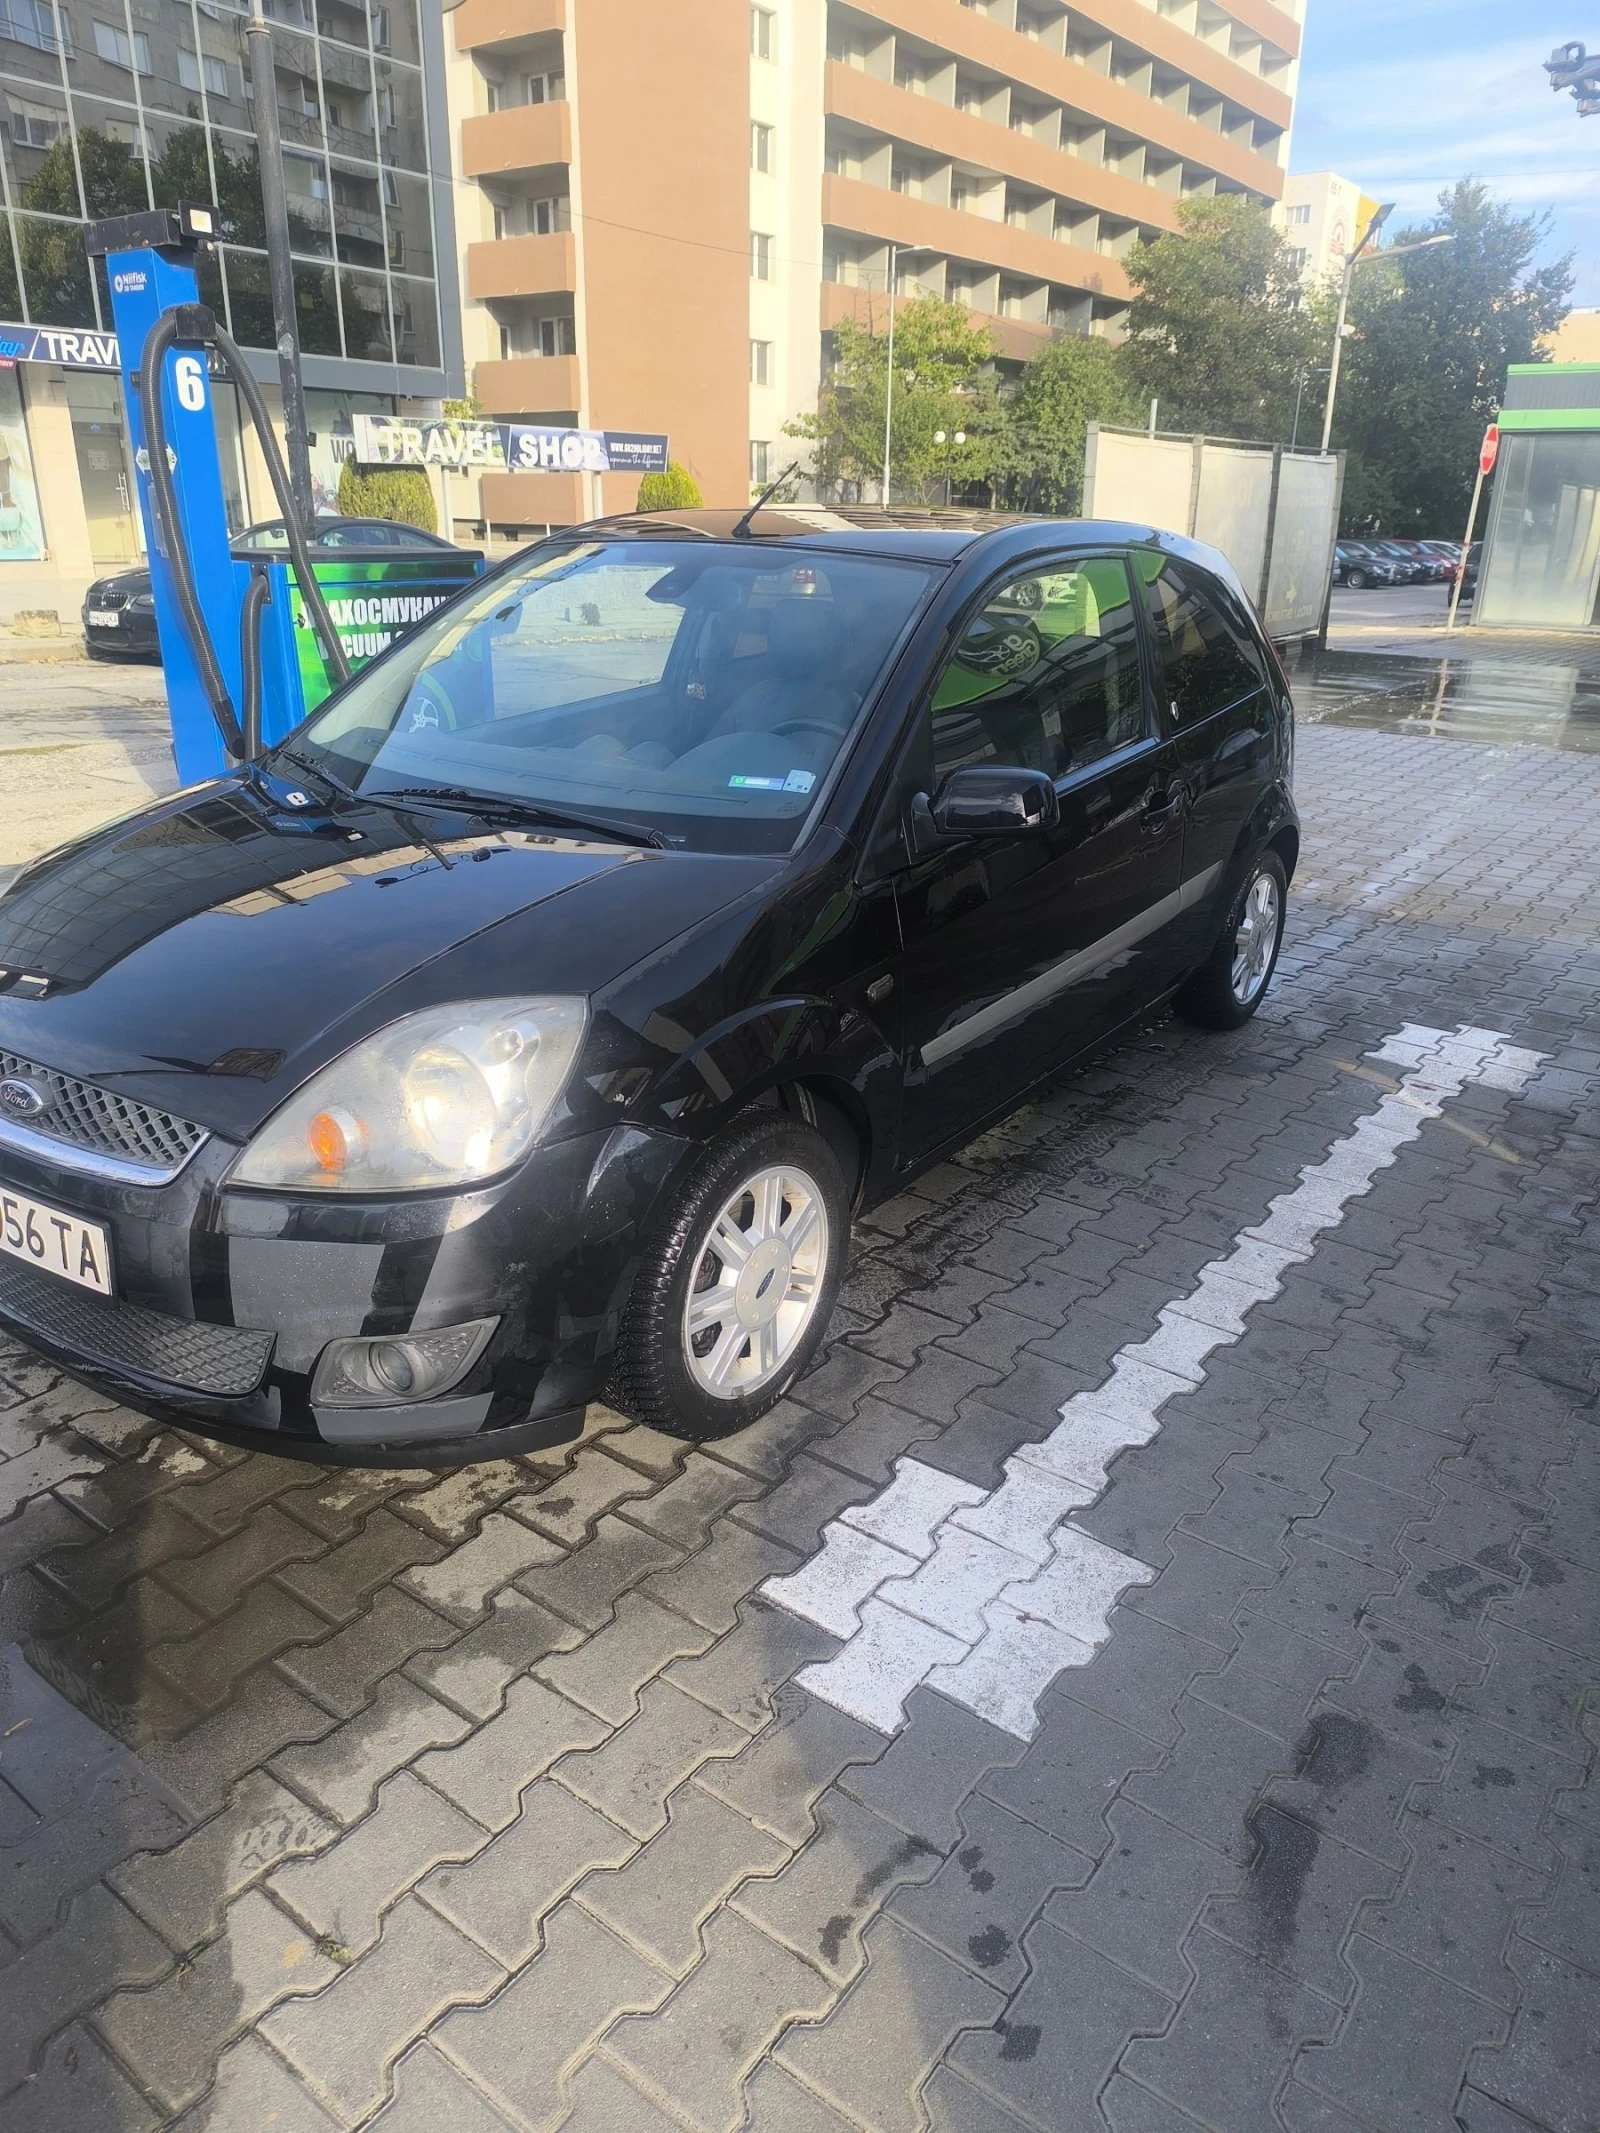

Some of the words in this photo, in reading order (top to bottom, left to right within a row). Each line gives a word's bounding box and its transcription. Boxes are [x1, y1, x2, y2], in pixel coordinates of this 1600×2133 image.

[122, 272, 147, 284] Nilfisk
[175, 357, 206, 411] 6
[379, 425, 504, 466] TRAVEL
[519, 434, 600, 467] SHOP
[4, 1085, 29, 1108] Ford
[50, 1216, 102, 1284] TA
